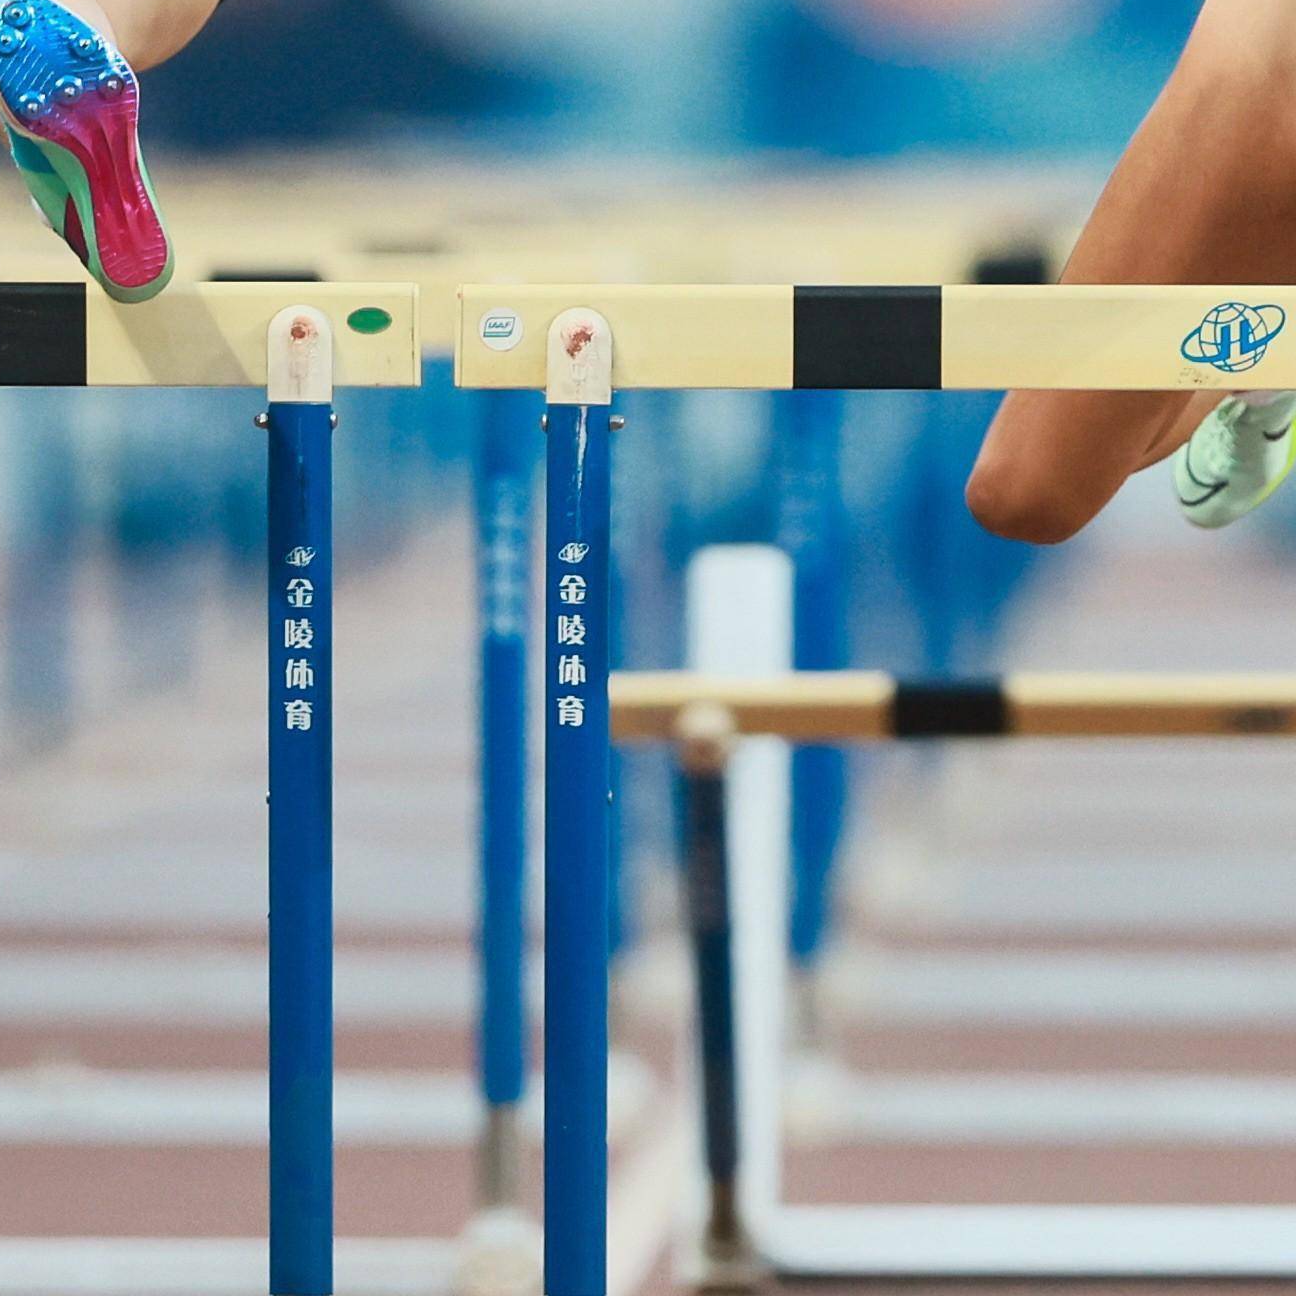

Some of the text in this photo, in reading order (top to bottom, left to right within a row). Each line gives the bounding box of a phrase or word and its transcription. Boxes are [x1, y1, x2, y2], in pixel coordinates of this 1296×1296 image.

[284, 578, 315, 731] 金陵体育
[557, 574, 586, 728] 金陵体育
